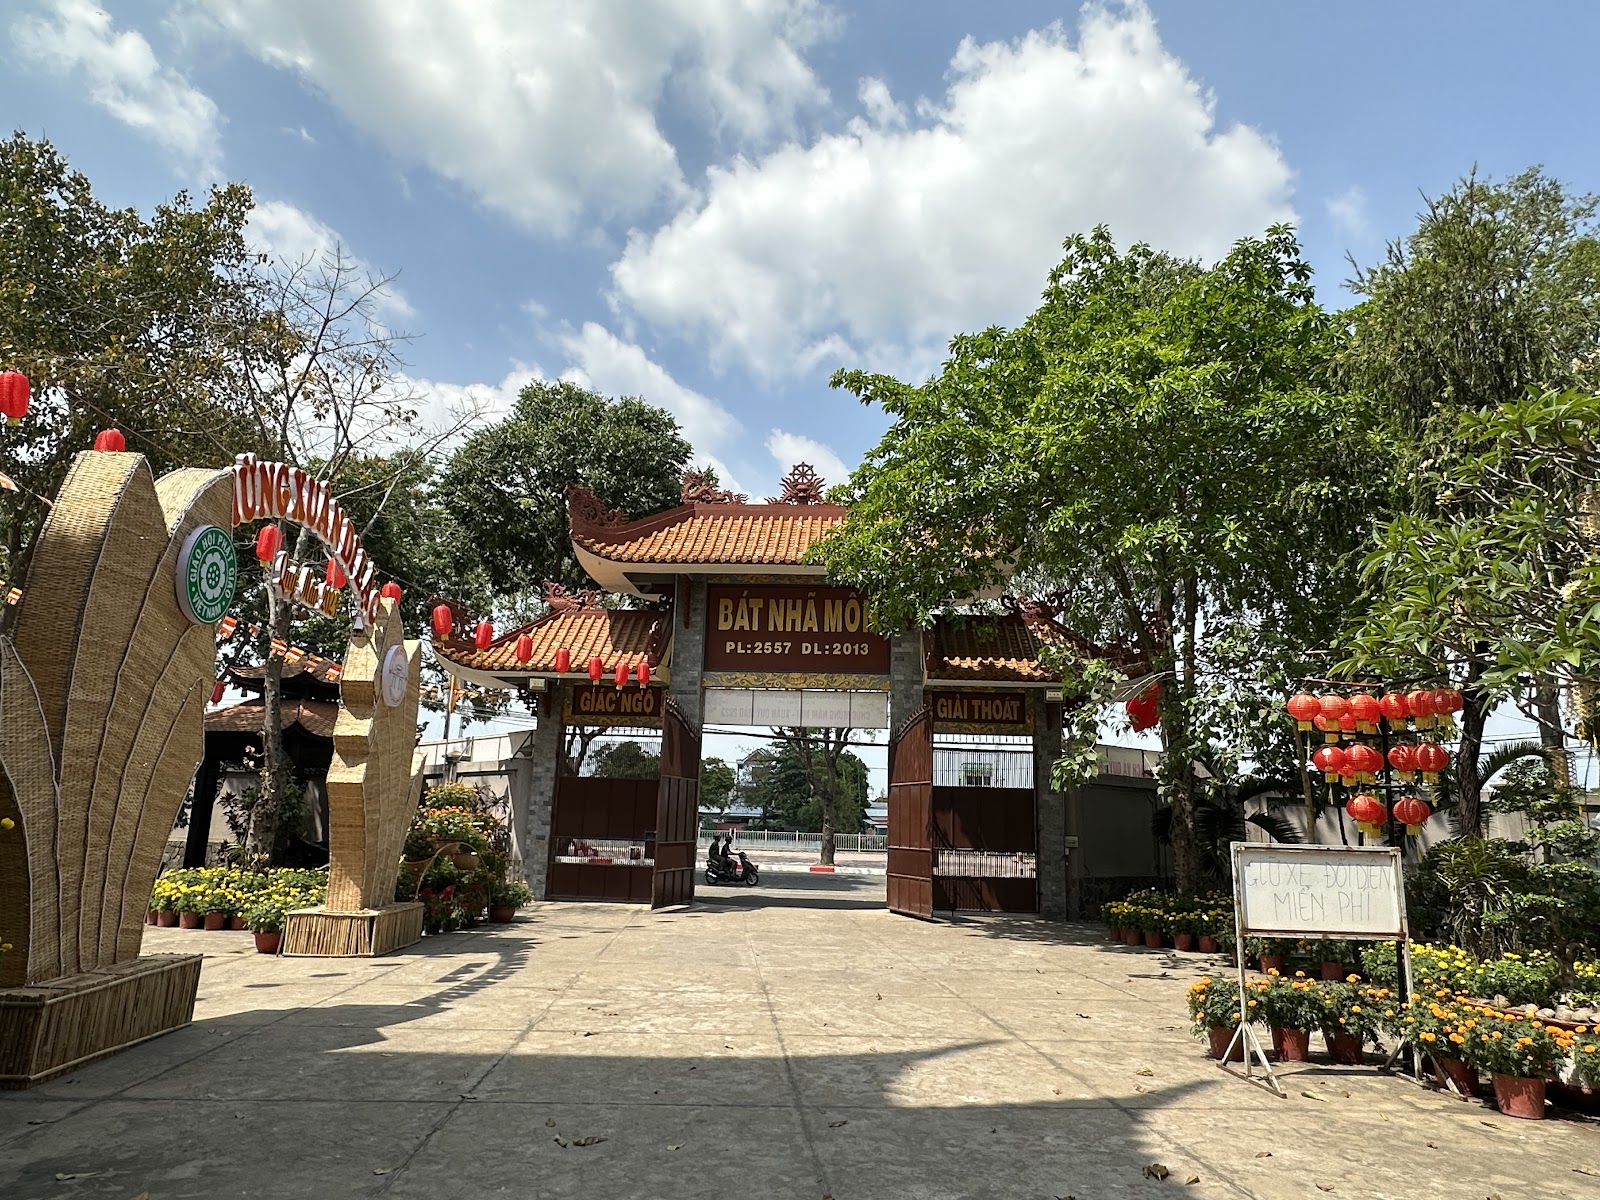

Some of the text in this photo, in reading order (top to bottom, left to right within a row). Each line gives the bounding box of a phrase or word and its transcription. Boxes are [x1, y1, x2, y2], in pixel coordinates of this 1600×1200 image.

[290, 467, 347, 547] XUÂN
[717, 590, 764, 631] BÁT
[768, 591, 819, 633] NHÃ
[725, 641, 869, 656] PL:2557 DL:2013
[579, 688, 616, 713] GIÁC
[936, 693, 1021, 721] GIẢI THOÁT
[1287, 862, 1312, 887] XE
